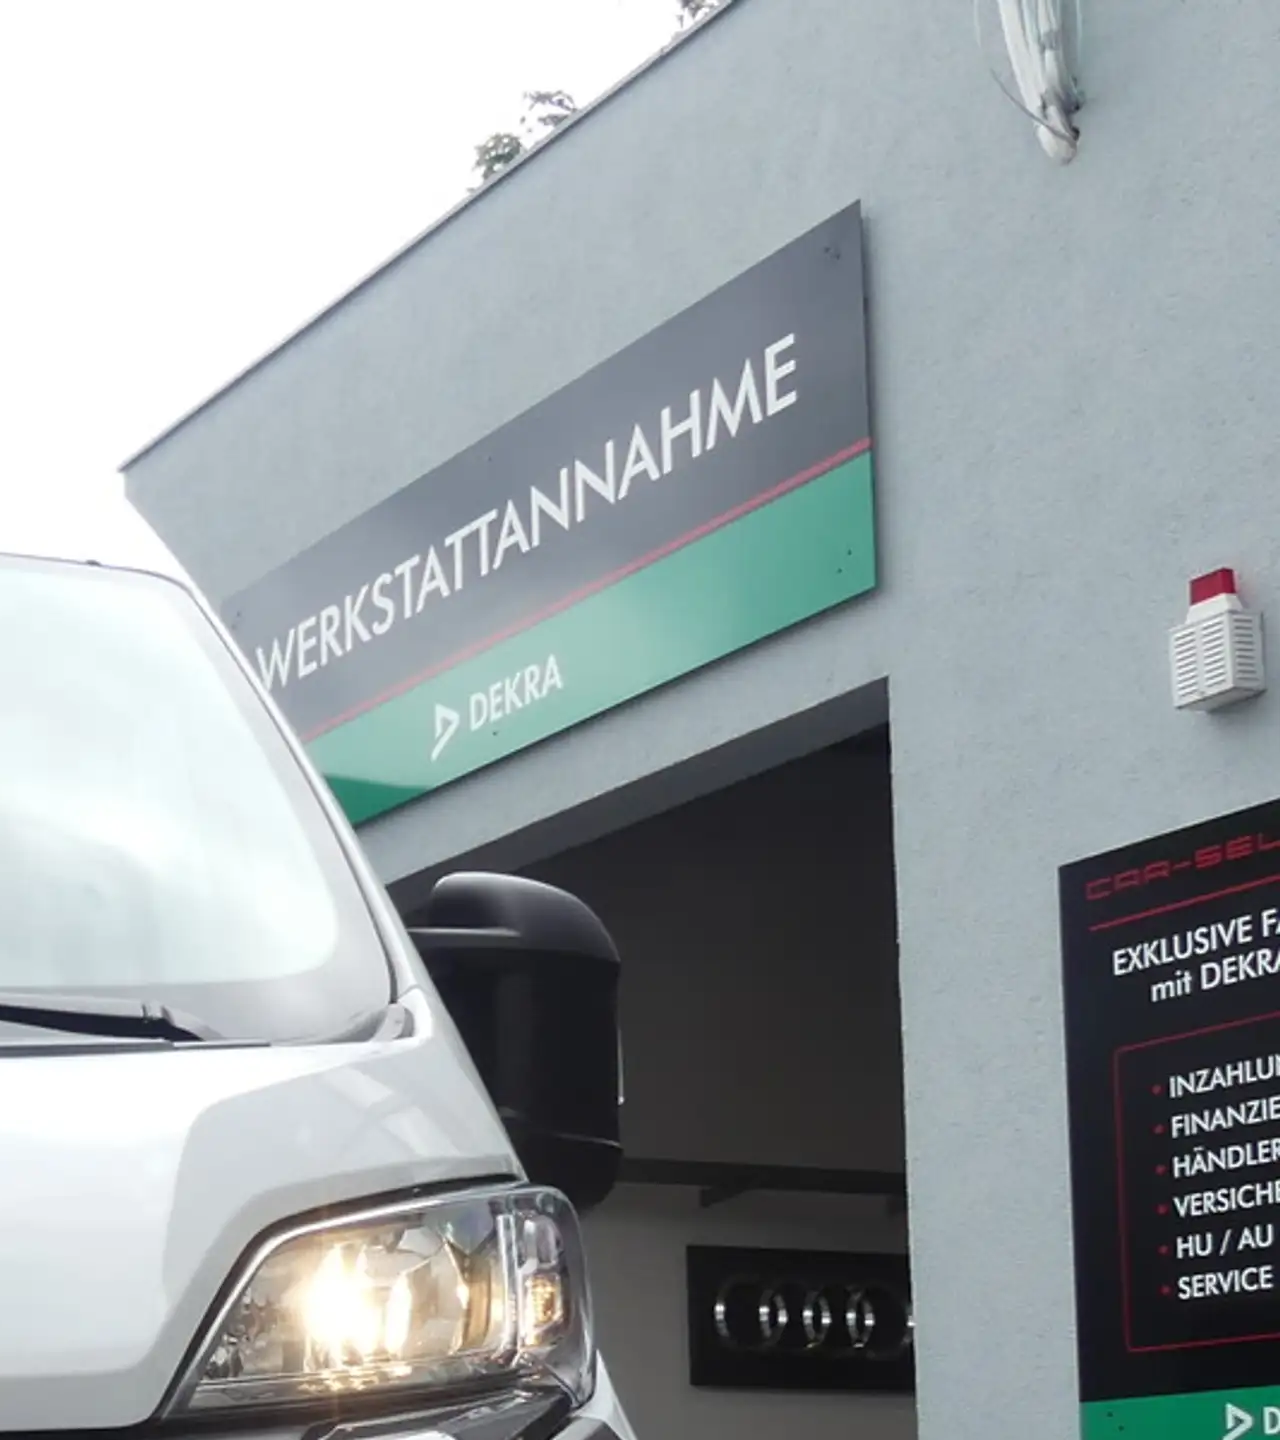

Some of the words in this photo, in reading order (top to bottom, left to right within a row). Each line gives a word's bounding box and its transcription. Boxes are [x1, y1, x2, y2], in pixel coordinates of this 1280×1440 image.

[256, 333, 798, 692] WERKSTATTANNAHME
[469, 654, 564, 732] DEKRA
[1112, 914, 1253, 976] EXKLUSIVE
[1261, 908, 1280, 938] F
[1151, 969, 1192, 1002] mit
[1171, 1094, 1280, 1139] FINANZIE
[1176, 1232, 1213, 1259] HU
[1237, 1223, 1274, 1251] AU
[1178, 1265, 1274, 1300] SERVICE
